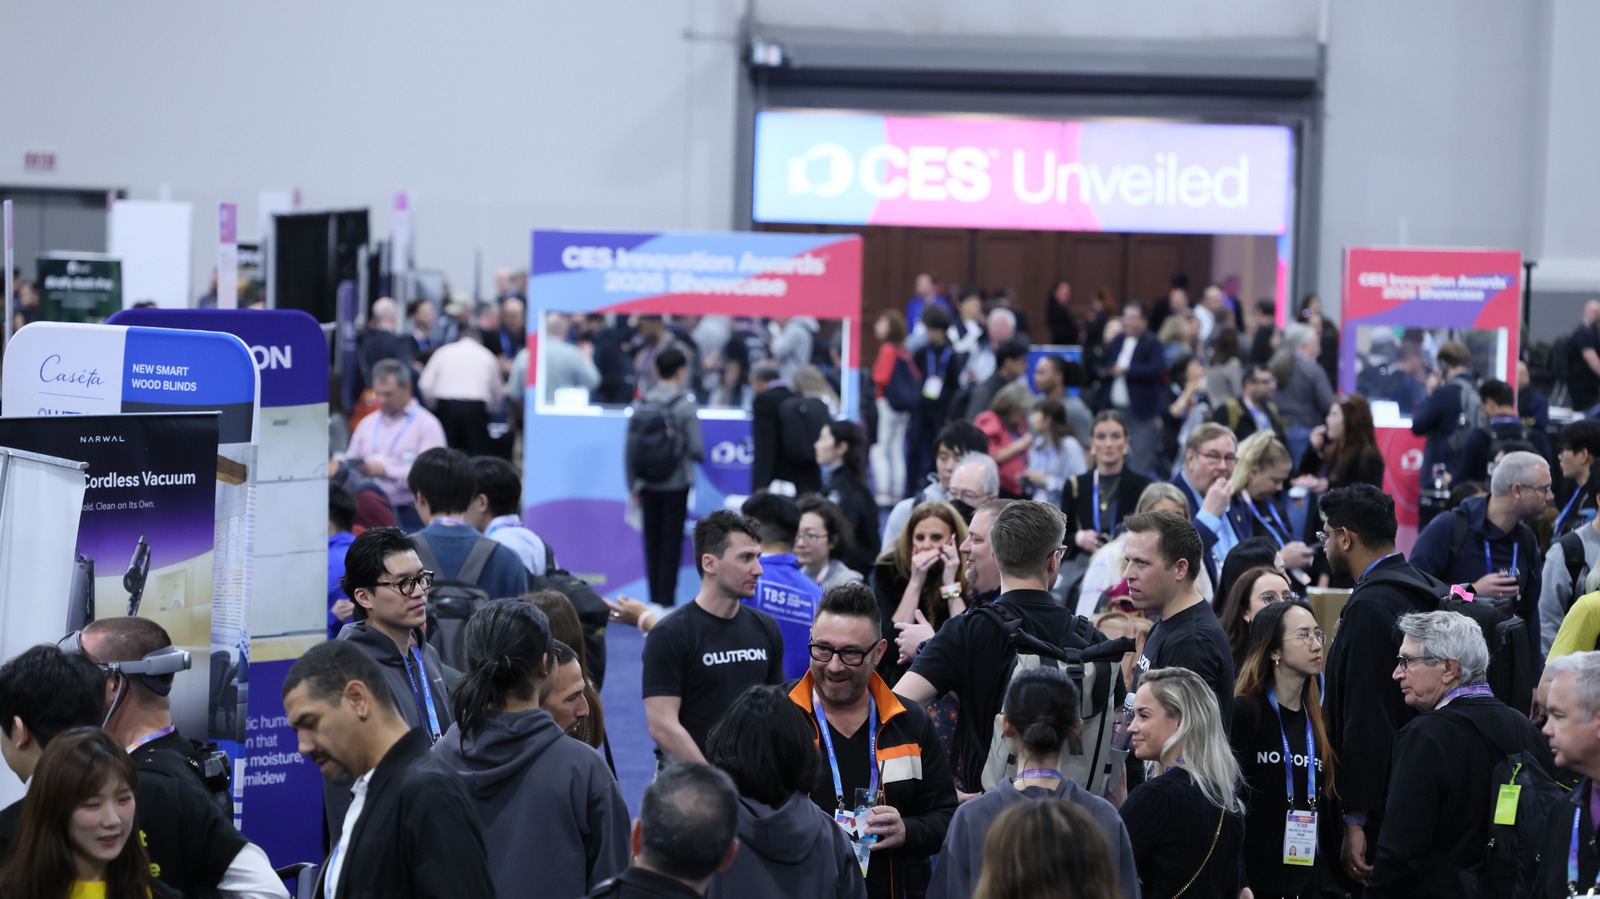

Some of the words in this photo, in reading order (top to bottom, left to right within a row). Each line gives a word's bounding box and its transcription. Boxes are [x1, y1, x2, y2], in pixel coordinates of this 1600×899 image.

[858, 145, 991, 201] CES
[1012, 148, 1249, 208] Unveiled
[561, 245, 614, 270] CES
[616, 247, 735, 272] Innovation
[738, 251, 826, 276] Awards
[603, 270, 666, 293] 2026
[669, 271, 788, 297] Showcase
[39, 354, 104, 388] Caséta
[132, 363, 155, 374] NEW
[155, 366, 189, 376] SMART
[131, 378, 162, 390] WOOD
[162, 381, 197, 392] BLINDS
[80, 435, 125, 443] NARWAL
[84, 472, 140, 489] Cordless
[141, 471, 196, 486] Vacuum
[95, 501, 116, 511] Clean
[117, 502, 127, 510] on
[128, 501, 138, 509] Its
[138, 500, 155, 508] Own.
[763, 587, 787, 605] TBS
[256, 734, 278, 748] that
[250, 751, 304, 767] moisture,
[1257, 751, 1280, 764] NO
[243, 770, 286, 786] mildew
